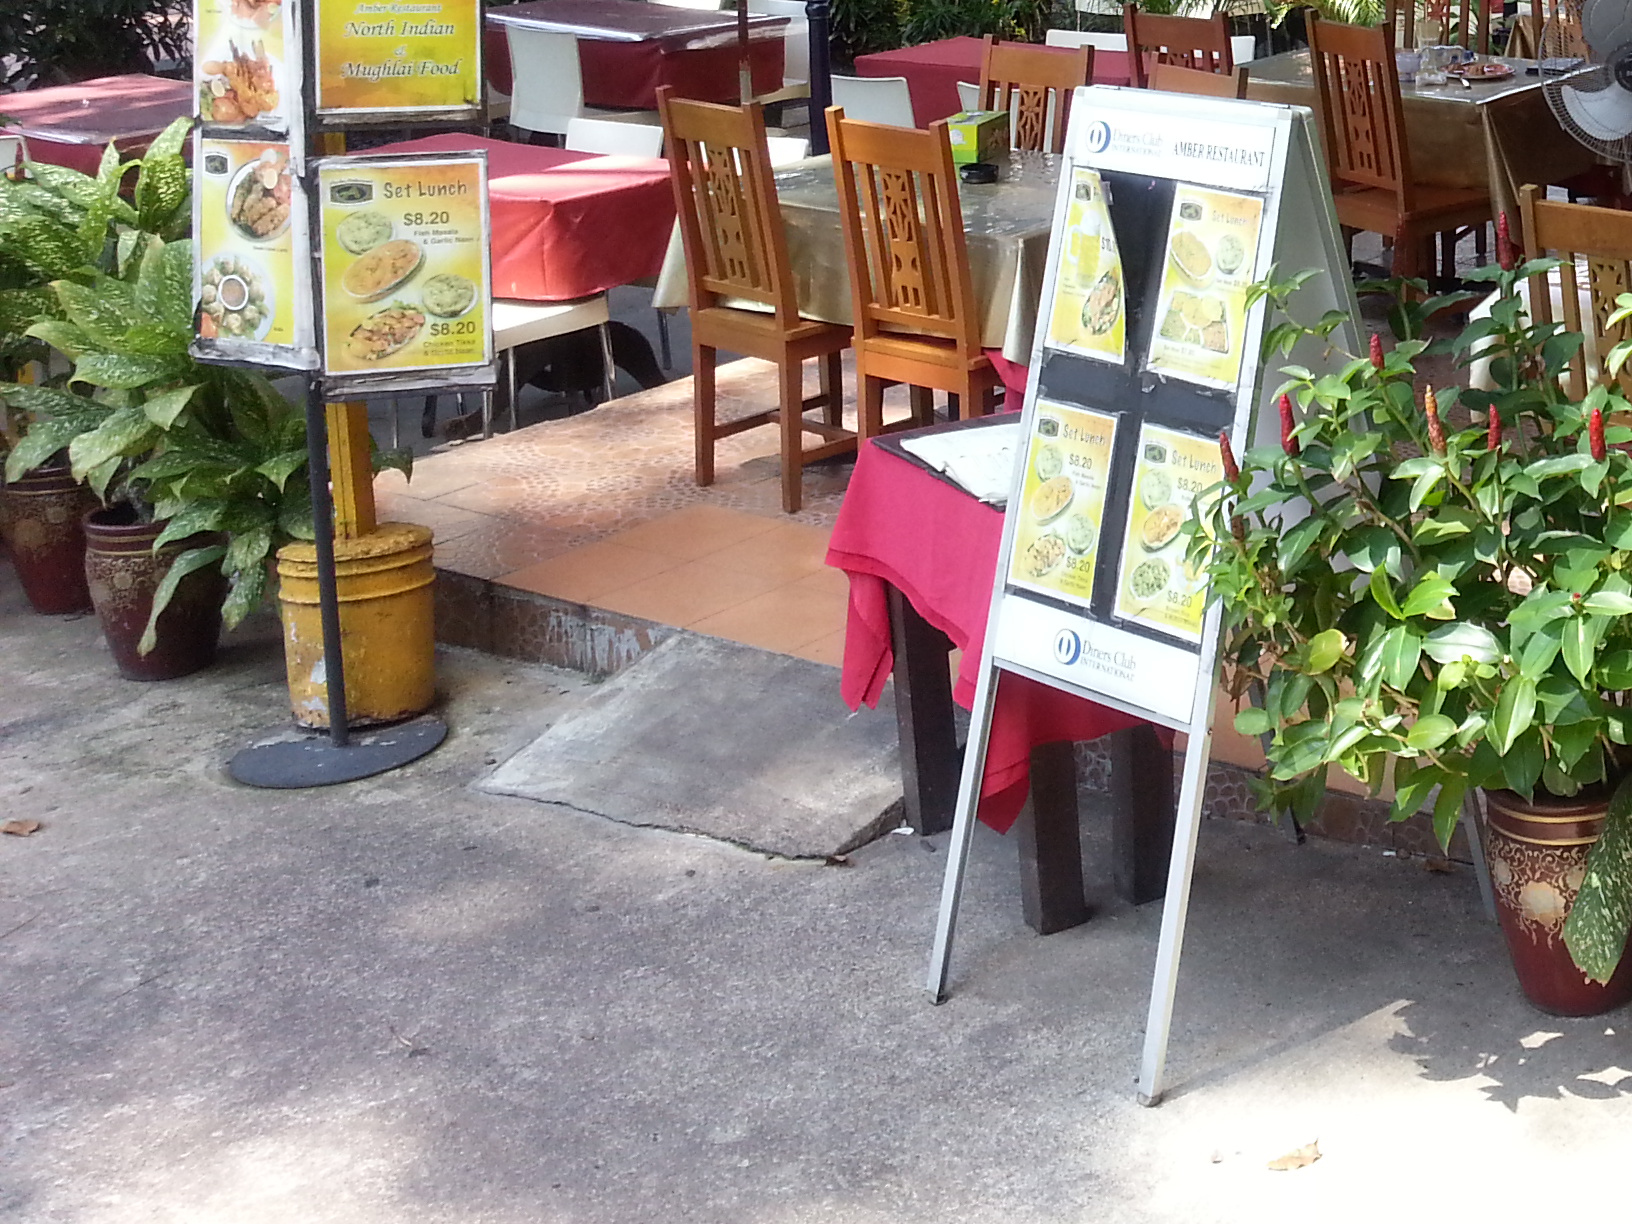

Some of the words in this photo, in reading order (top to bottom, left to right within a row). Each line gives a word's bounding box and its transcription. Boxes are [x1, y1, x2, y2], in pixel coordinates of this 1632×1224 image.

[355, 3, 387, 14] Amber
[389, 3, 442, 14] Restaurant
[344, 19, 395, 37] North
[399, 19, 455, 36] Indian
[342, 59, 412, 81] Mughlai
[418, 58, 463, 76] Food
[1113, 128, 1140, 143] Diners
[1142, 132, 1163, 147] Club
[1173, 141, 1204, 160] AMBER
[1206, 144, 1266, 167] RESTAURANT
[383, 181, 412, 199] Set
[418, 179, 467, 197] Lunch
[403, 211, 449, 226] $8.20
[1212, 209, 1224, 223] Set
[430, 321, 476, 336] $8.20
[1062, 423, 1078, 439] Set
[1080, 427, 1106, 445] Lunch
[1068, 453, 1093, 471] $8.20
[1171, 449, 1187, 466] Set
[1188, 454, 1217, 474] Lunch
[1065, 555, 1090, 573] $8.20
[1166, 590, 1192, 608] $8.20
[1082, 640, 1111, 662] Diners
[1114, 651, 1136, 670] Club
